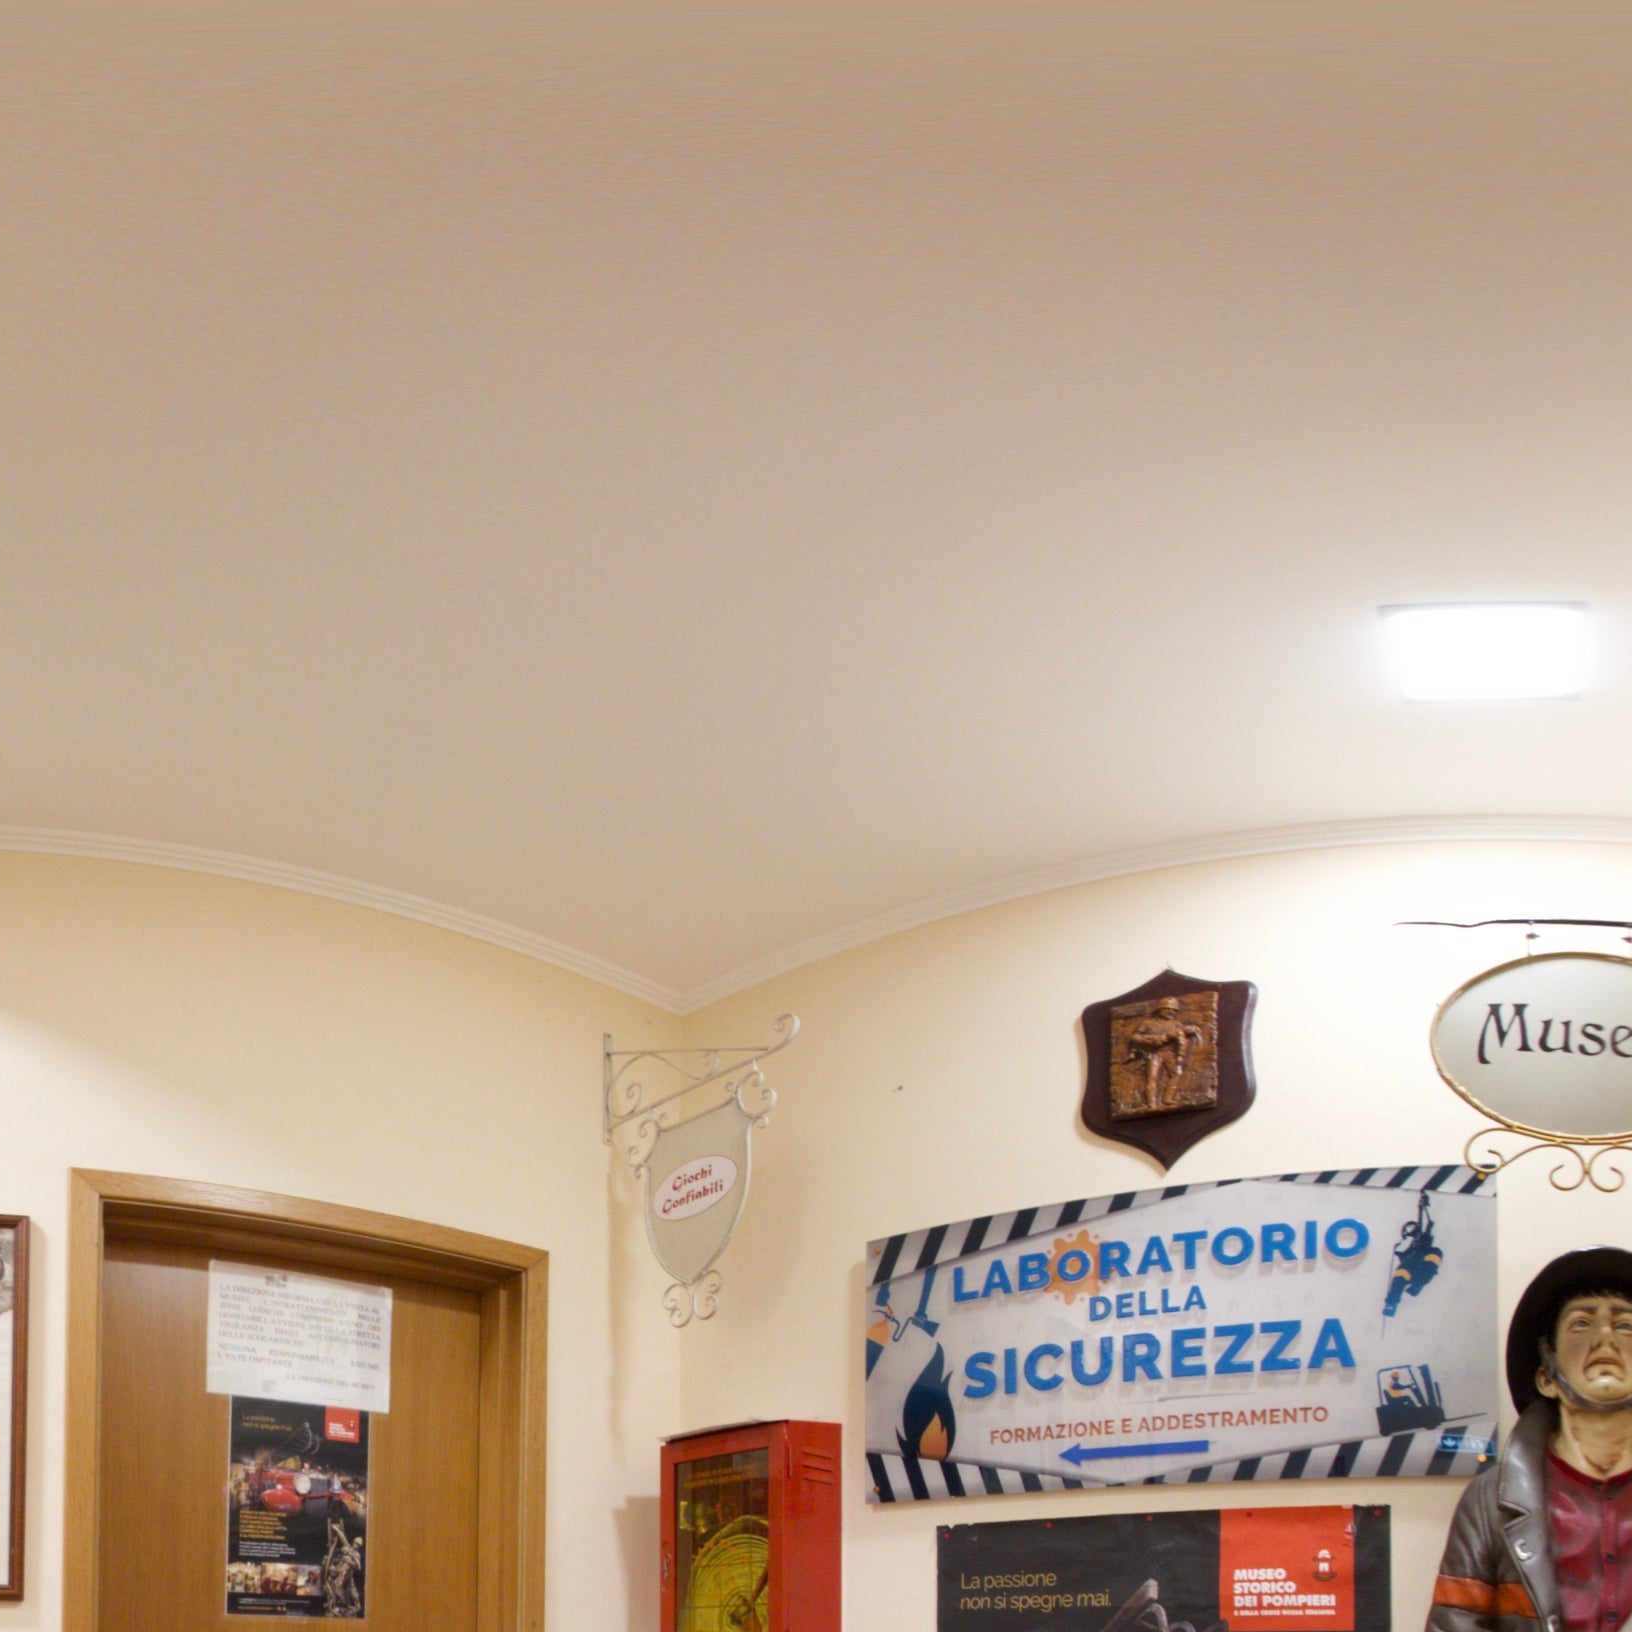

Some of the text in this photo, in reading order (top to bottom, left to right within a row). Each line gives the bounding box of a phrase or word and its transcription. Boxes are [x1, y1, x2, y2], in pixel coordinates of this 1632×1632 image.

[672, 1164, 712, 1191] Giochi
[662, 1179, 723, 1214] Gonfiabili
[952, 1217, 1372, 1303] LABORATORIO
[1088, 1285, 1208, 1322] DELLA
[963, 1316, 1357, 1401] SICUREZZA
[989, 1405, 1329, 1445] FORMAZIONE E ADDESTRAMENTO
[960, 1570, 1057, 1593] La passione
[1233, 1567, 1287, 1580] MUSEO
[960, 1589, 1111, 1613] non si spegne mai.
[1233, 1581, 1297, 1594] STORICO
[1234, 1594, 1336, 1607] DEI POMPIERI
